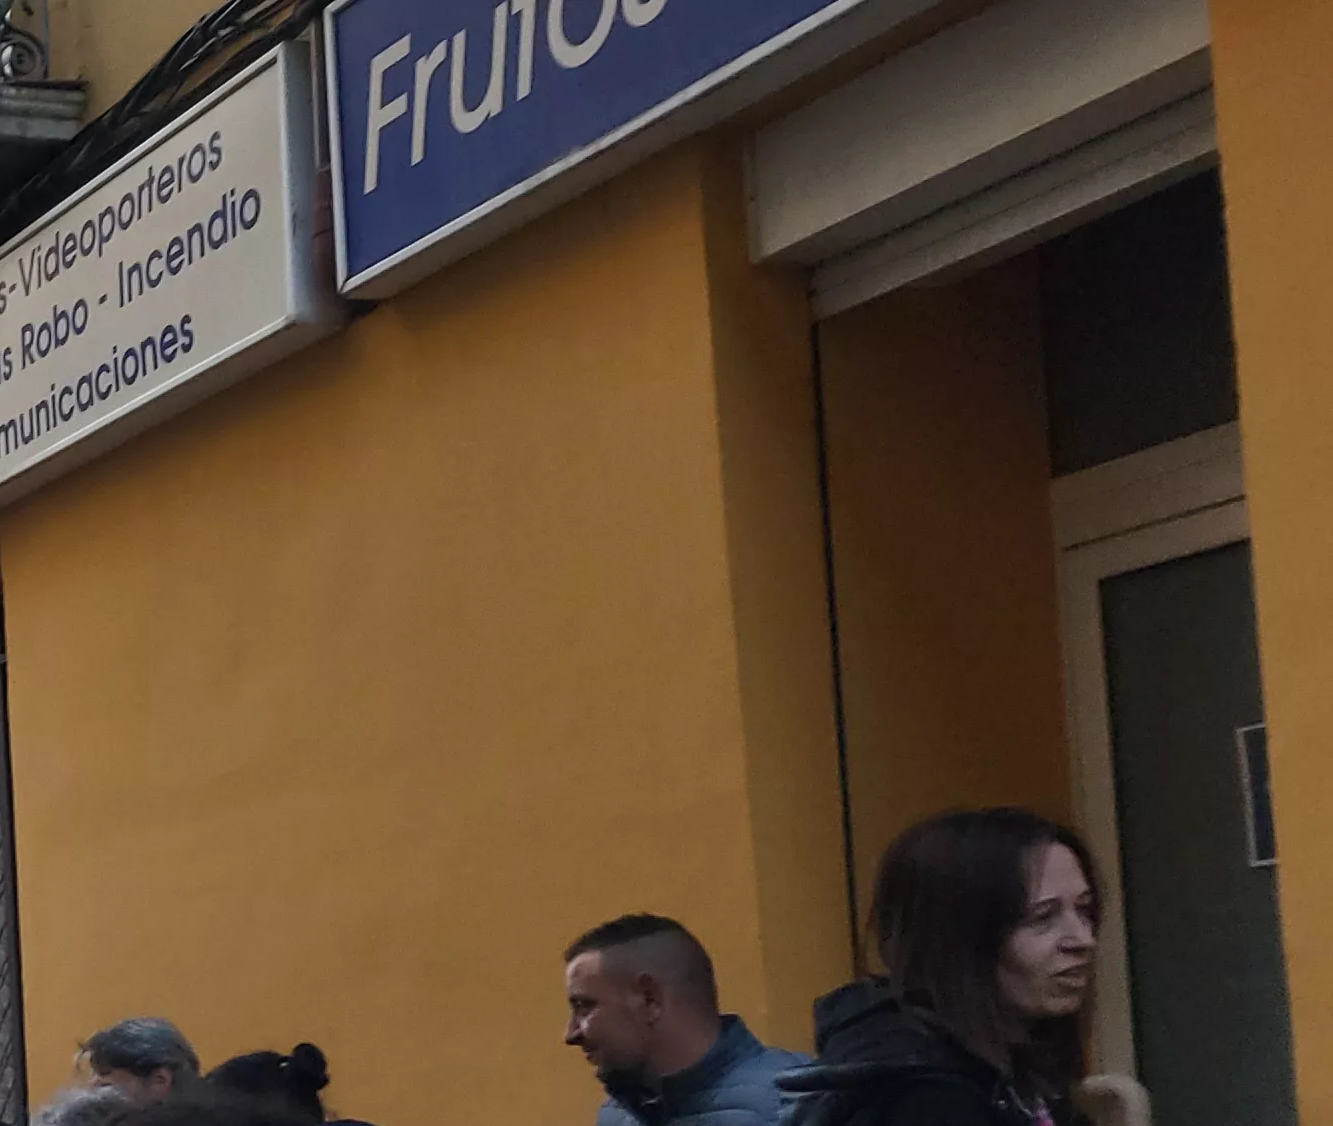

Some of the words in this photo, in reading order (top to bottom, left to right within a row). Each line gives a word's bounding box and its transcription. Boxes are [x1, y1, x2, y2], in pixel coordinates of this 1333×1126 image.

[363, 0, 666, 195] Fruto
[21, 297, 89, 370] Robo
[118, 187, 262, 309] Incendio
